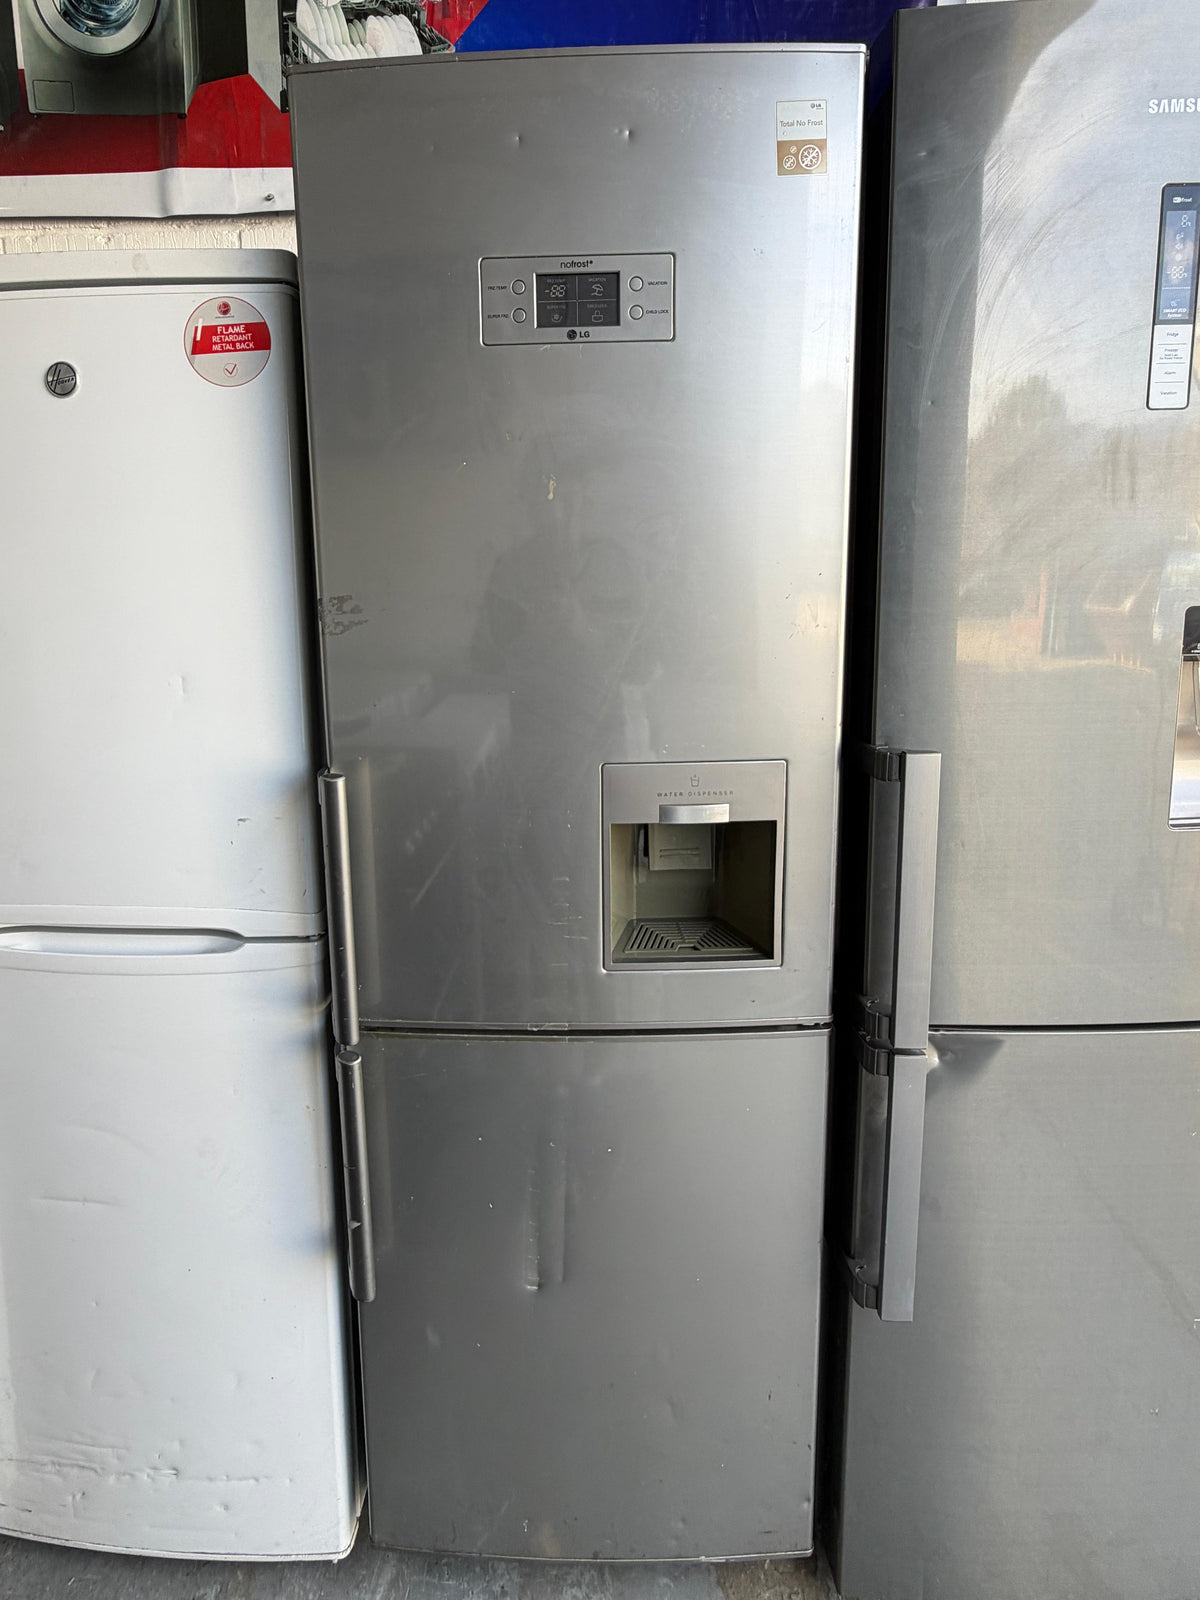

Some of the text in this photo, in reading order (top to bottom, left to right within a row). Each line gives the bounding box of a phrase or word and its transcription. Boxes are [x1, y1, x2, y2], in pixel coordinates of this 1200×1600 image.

[780, 120, 795, 128] Total
[796, 119, 806, 127] No
[217, 325, 246, 334] FLAME
[212, 333, 252, 343] RETARDANT
[579, 331, 590, 339] LG
[235, 342, 255, 350] BACK
[687, 790, 735, 798] DISPENSER
